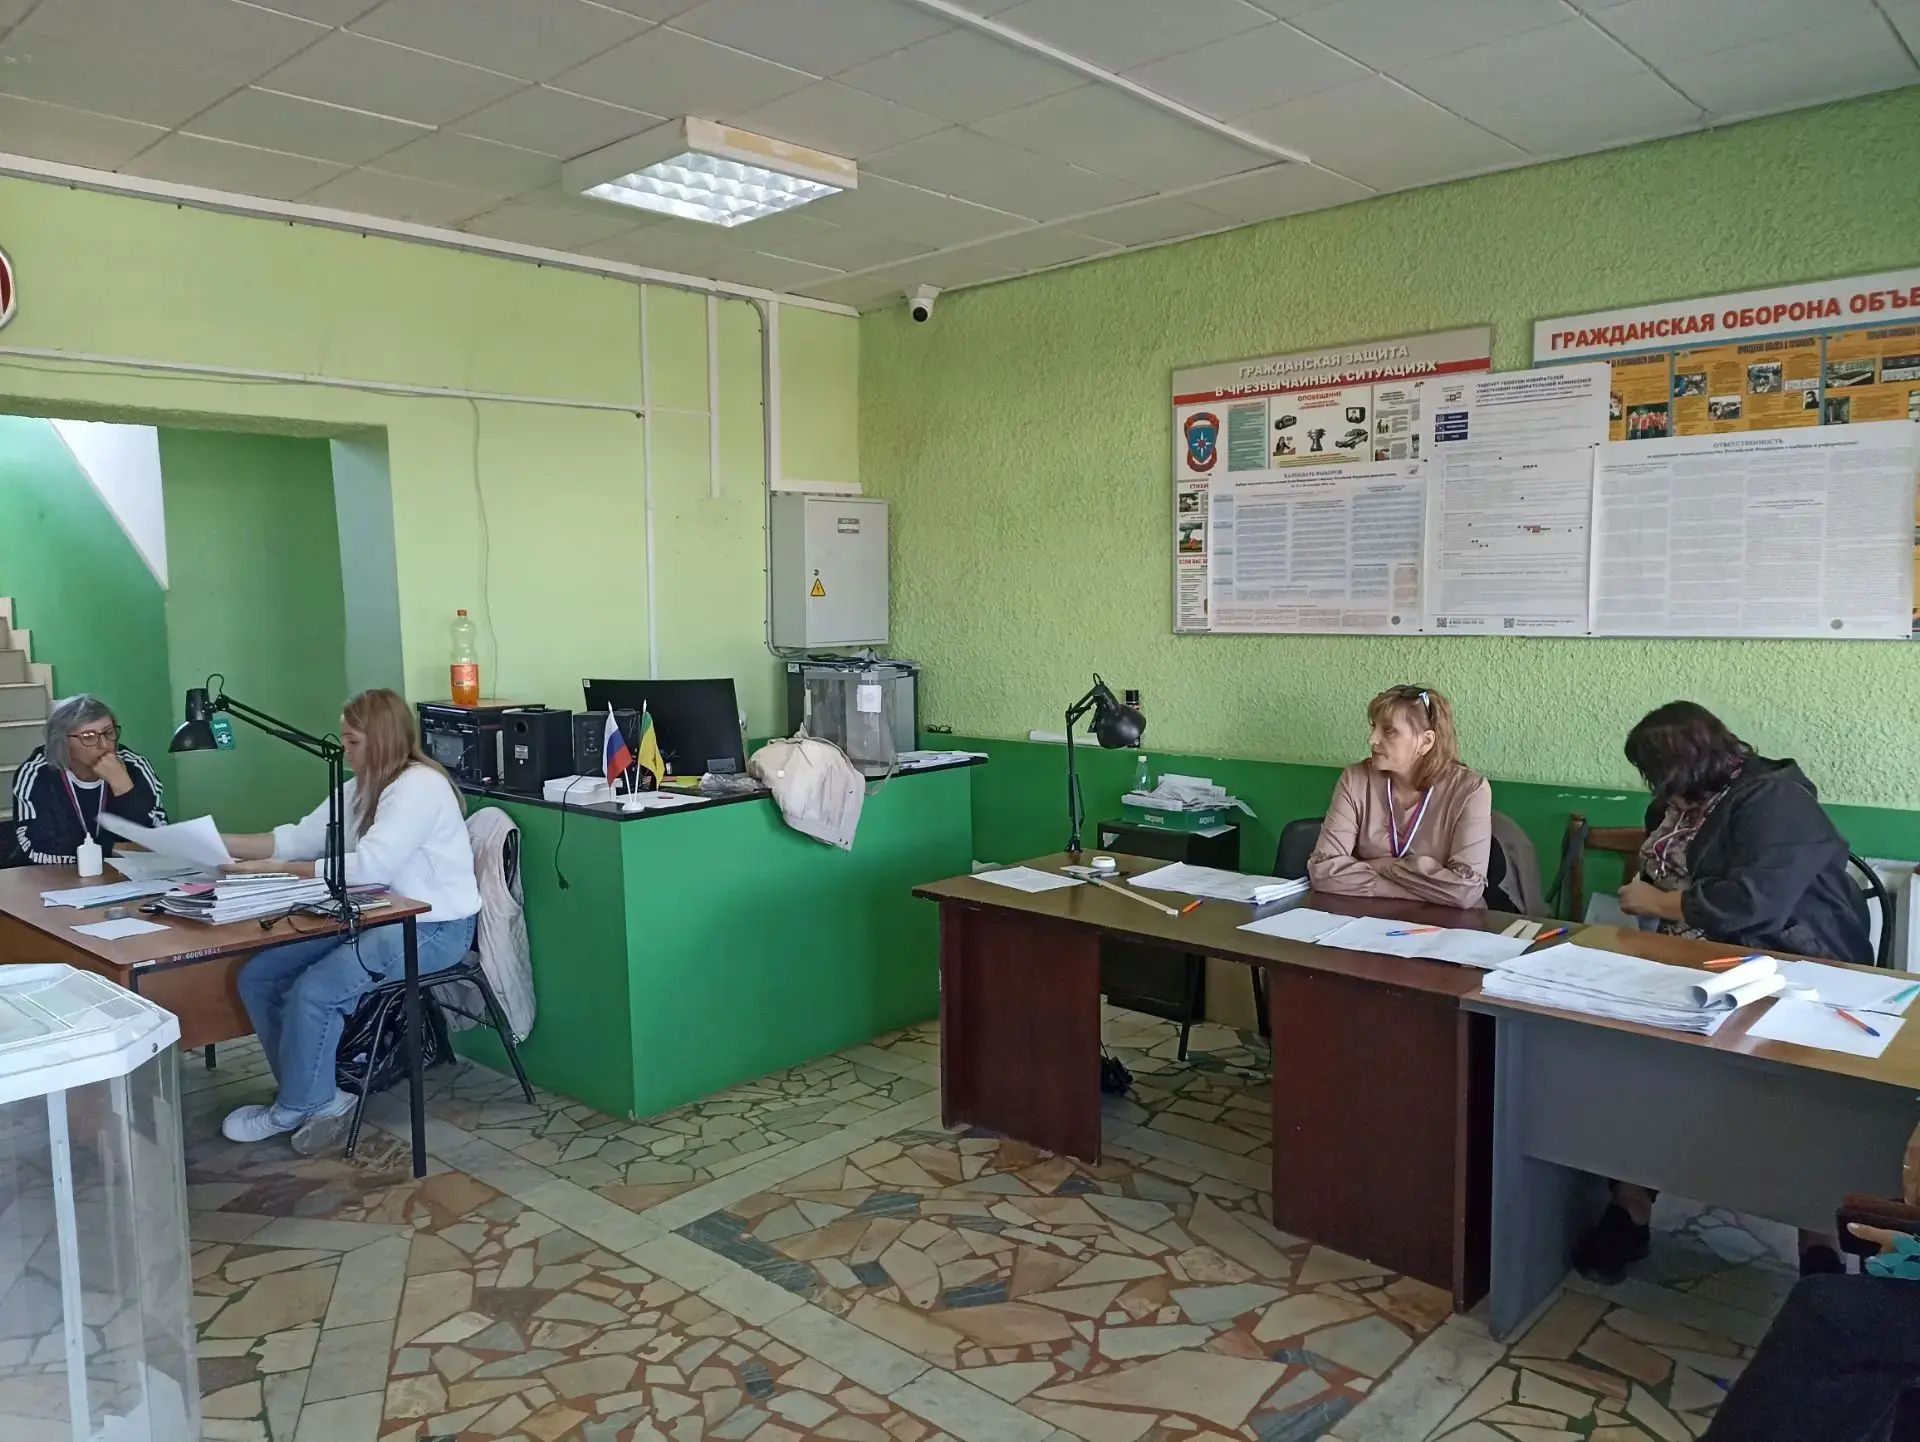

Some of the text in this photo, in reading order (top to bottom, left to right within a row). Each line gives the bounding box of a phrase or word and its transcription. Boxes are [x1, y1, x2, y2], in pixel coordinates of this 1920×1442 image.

[1551, 312, 1715, 350] ГРАЖДАНСКАЯ
[1722, 296, 1840, 330] ОБОРОНА
[1849, 286, 1920, 314] ОБЪЕ
[1215, 361, 1438, 397] В ЧРЕЗВЫЧАЙНЫХ СИТУАЦИЯХ
[1239, 345, 1409, 379] ГРАЖДАНСКАЯ ЗАЩИТА
[1297, 391, 1342, 402] ОПОВЕЩЕНИЕ
